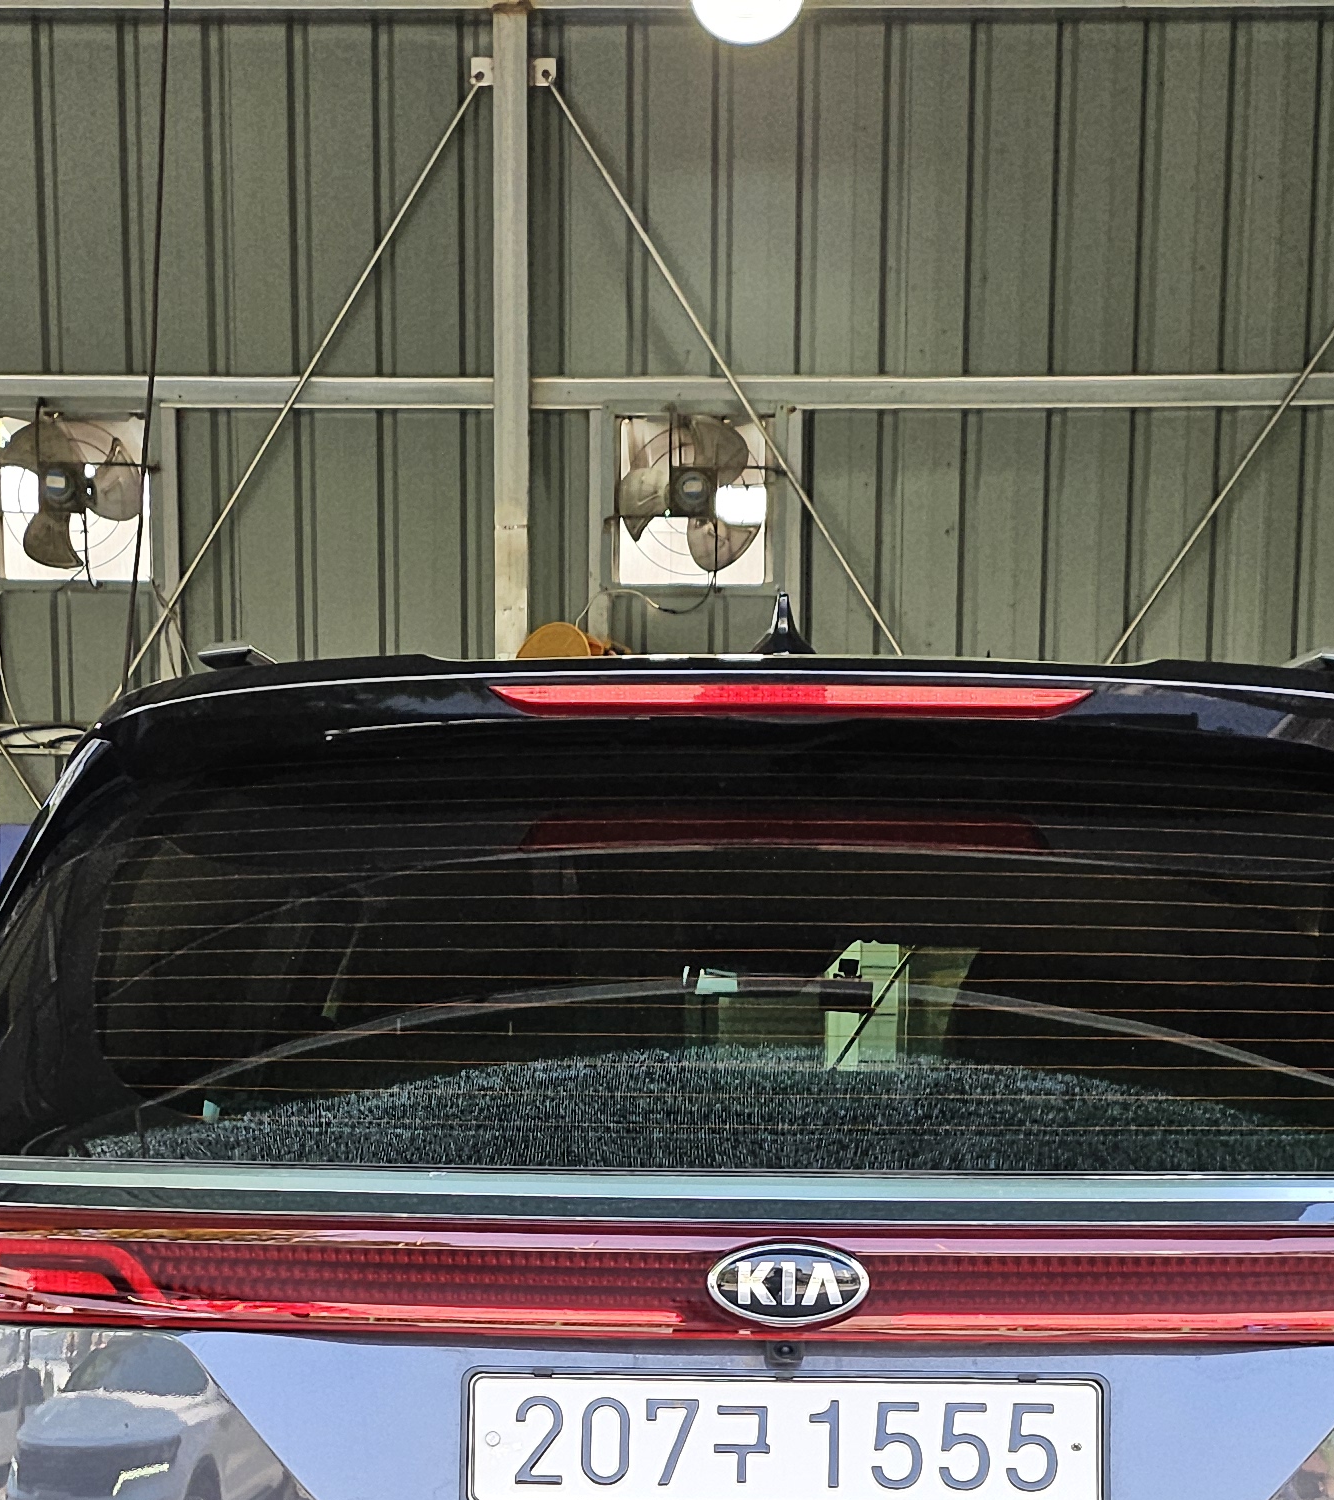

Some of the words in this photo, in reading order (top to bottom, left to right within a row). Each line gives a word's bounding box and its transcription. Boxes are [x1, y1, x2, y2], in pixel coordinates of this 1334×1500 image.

[736, 1261, 844, 1306] KIA
[514, 1395, 770, 1487] 207구
[808, 1399, 1058, 1492] 1555
